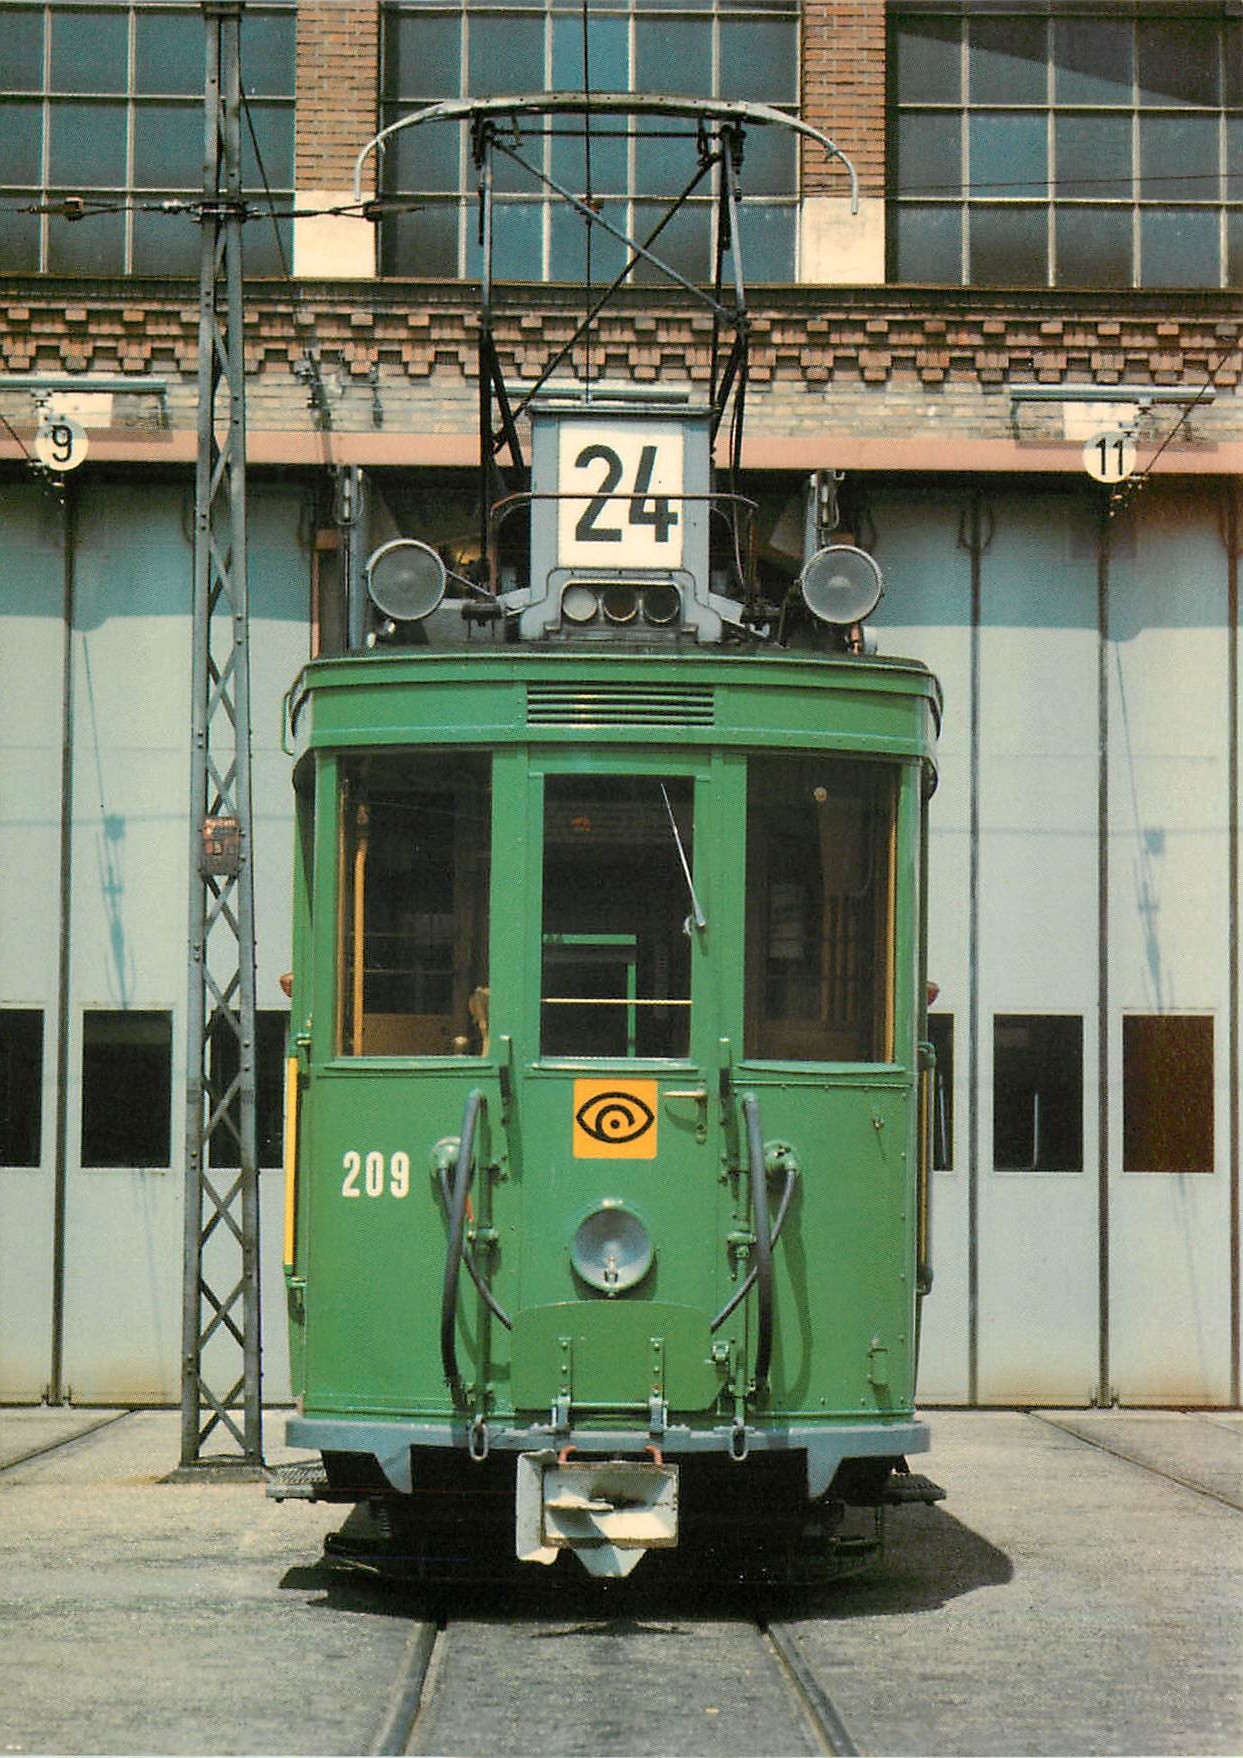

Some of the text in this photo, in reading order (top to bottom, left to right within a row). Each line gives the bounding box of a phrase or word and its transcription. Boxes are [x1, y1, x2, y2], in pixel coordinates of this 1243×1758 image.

[52, 424, 73, 462] 9
[1096, 437, 1124, 476] 11
[575, 444, 679, 543] 24
[342, 1151, 409, 1198] 209
